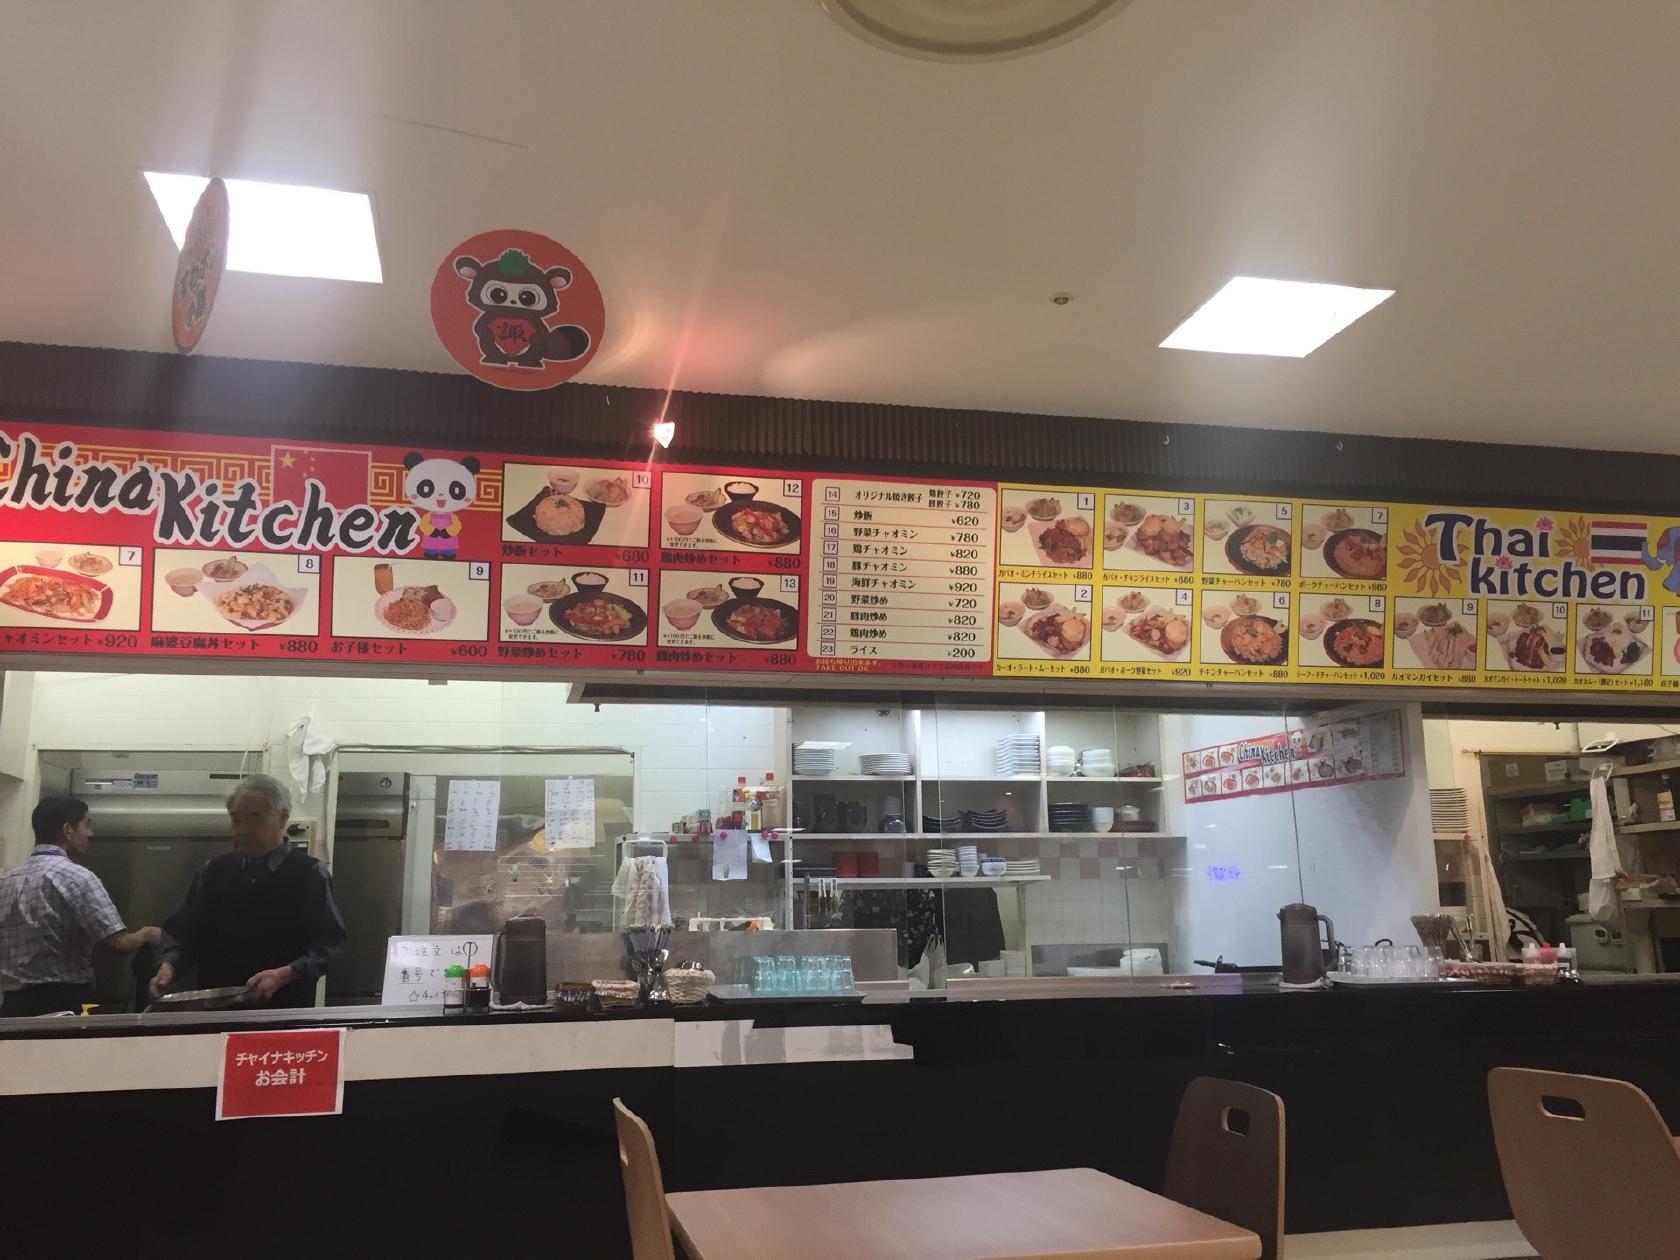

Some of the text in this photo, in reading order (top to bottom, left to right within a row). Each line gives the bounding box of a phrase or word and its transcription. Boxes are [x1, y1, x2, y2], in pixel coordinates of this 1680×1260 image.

[0, 434, 156, 512] hina
[636, 474, 649, 485] 10
[787, 482, 800, 493] 12
[828, 490, 838, 499] 14
[955, 490, 980, 501] ¥720
[955, 500, 980, 510] ¥780
[1183, 502, 1190, 511] 3
[828, 509, 838, 518] 15
[1281, 506, 1288, 516] 5
[1377, 511, 1383, 520] 7
[854, 511, 979, 527] 炒飯 ¥620
[853, 528, 979, 543] 野菜チャオミン ¥780
[1425, 513, 1550, 562] Thai
[502, 544, 563, 558] 炒飯セット
[826, 544, 836, 552] 17
[127, 550, 137, 561] 7
[950, 549, 978, 560] ¥820
[304, 557, 315, 569] 8
[768, 556, 801, 569] ¥880
[474, 564, 485, 576] 9
[949, 566, 978, 576] ¥880
[633, 572, 645, 583] 11
[826, 577, 835, 585] 19
[1271, 579, 1292, 587] ¥780
[1470, 557, 1646, 600] kitchen
[783, 578, 797, 589] 13
[851, 577, 977, 592] 海鮮チャオミン ¥920
[824, 594, 836, 602] 20
[1080, 589, 1088, 598] 2
[1180, 592, 1188, 601] 4
[851, 594, 977, 609] 野菜炒め ¥720
[1278, 596, 1285, 605] 6
[1374, 599, 1381, 608] 8
[1466, 602, 1474, 611] 9
[1555, 605, 1566, 615] 10
[823, 611, 834, 619] 21
[1643, 609, 1651, 618] 11
[948, 615, 976, 626] ¥820
[822, 628, 834, 636] 22
[947, 632, 976, 642] ¥820
[97, 634, 138, 648] ¥920
[150, 637, 319, 653] 麻婆豆腐丼セット ¥880
[331, 640, 488, 658] お子様セット ¥600
[497, 646, 646, 662] 野菜炒めセット ¥780
[822, 645, 833, 653] 23
[850, 645, 976, 658] ライス ¥200
[764, 654, 797, 666] ¥880
[1171, 668, 1191, 676] ¥920
[235, 1049, 329, 1067] チャイナキッチン
[255, 1067, 307, 1087] お会計
